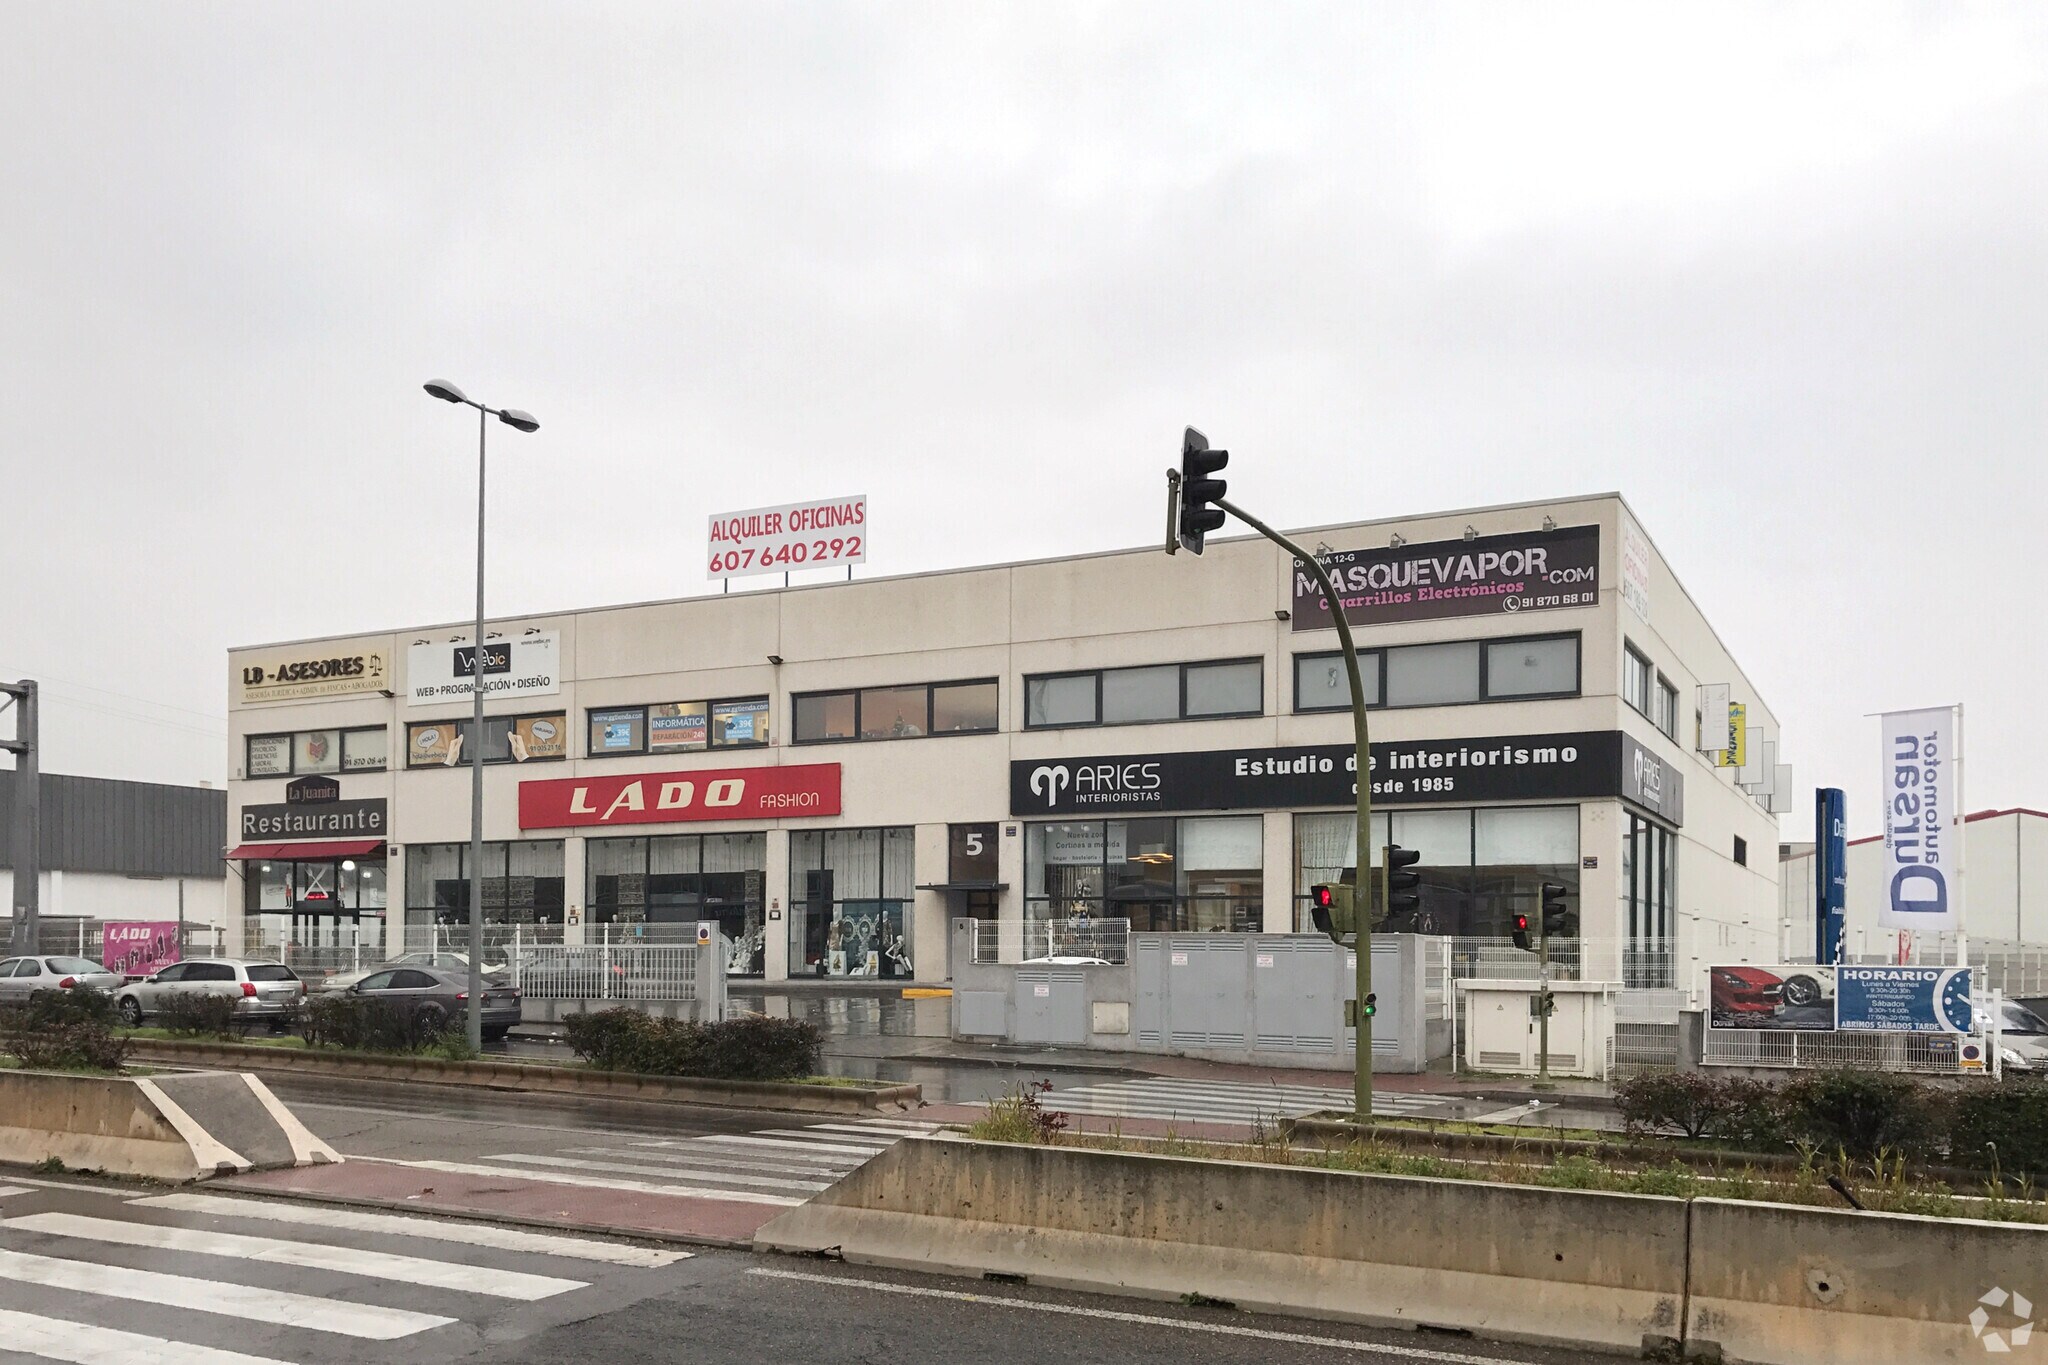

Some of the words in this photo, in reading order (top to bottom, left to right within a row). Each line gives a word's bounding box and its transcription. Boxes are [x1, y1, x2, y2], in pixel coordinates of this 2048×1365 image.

[711, 513, 782, 544] ALQUILER
[789, 502, 864, 532] OFICINAS
[709, 548, 756, 573] 607
[759, 542, 807, 567] 640
[812, 536, 861, 561] 292
[1334, 553, 1355, 564] 12-G
[1417, 580, 1525, 602] Electrónicos
[1522, 597, 1534, 608] 91
[1536, 595, 1559, 607] 870
[1562, 594, 1578, 605] 68
[1581, 593, 1594, 603] 01
[242, 666, 264, 685] LB
[276, 656, 364, 681] ASESORES
[416, 687, 436, 697] WEB
[440, 678, 511, 695] PROGRAACIÓN
[517, 674, 551, 689] DISEÑO
[652, 717, 706, 730] INFORMÁTICA
[693, 731, 705, 739] 24h
[1235, 755, 1333, 777] Estudio
[1390, 745, 1578, 770] interiorismo
[1075, 763, 1162, 792] ARIES
[1411, 776, 1455, 793] 1985
[569, 778, 746, 820] LADO
[760, 792, 820, 809] FASHION
[1075, 791, 1161, 804] INTERIORISTAS
[243, 808, 381, 834] Restaurante
[966, 833, 983, 856] 5
[109, 927, 151, 943] LADO
[1843, 970, 1938, 981] HORARIO
[1877, 1021, 1912, 1030] SÁBADOS
[1915, 1023, 1940, 1031] TARDE
